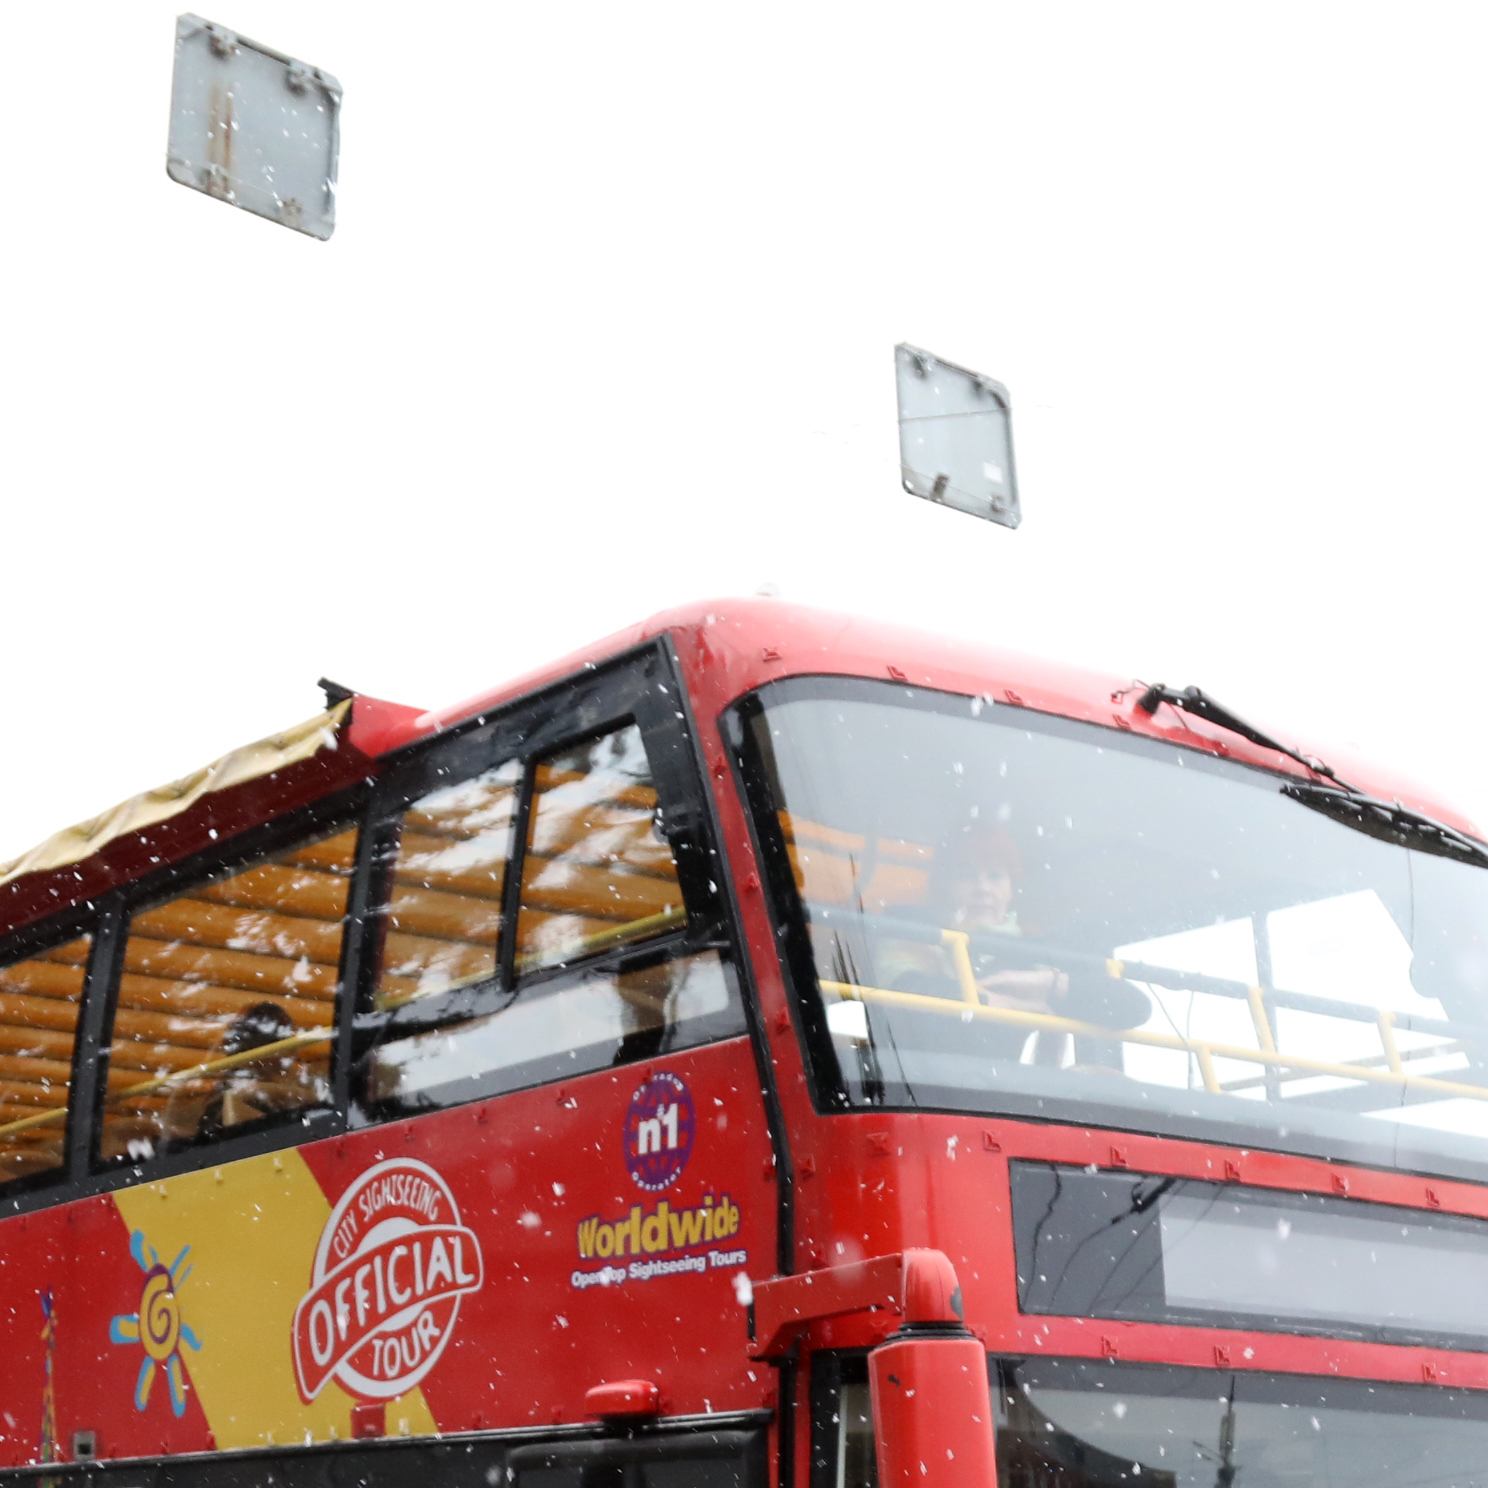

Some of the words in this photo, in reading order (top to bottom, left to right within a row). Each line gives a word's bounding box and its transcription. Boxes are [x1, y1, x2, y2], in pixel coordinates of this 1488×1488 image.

[333, 1209, 360, 1259] CITY
[359, 1173, 443, 1222] SIGHTSEEING
[577, 1194, 741, 1260] Worldwide
[628, 1253, 706, 1281] Sightseeing
[708, 1249, 748, 1267] Tours
[309, 1235, 475, 1367] OFFICIAL
[371, 1309, 441, 1379] TOUR
